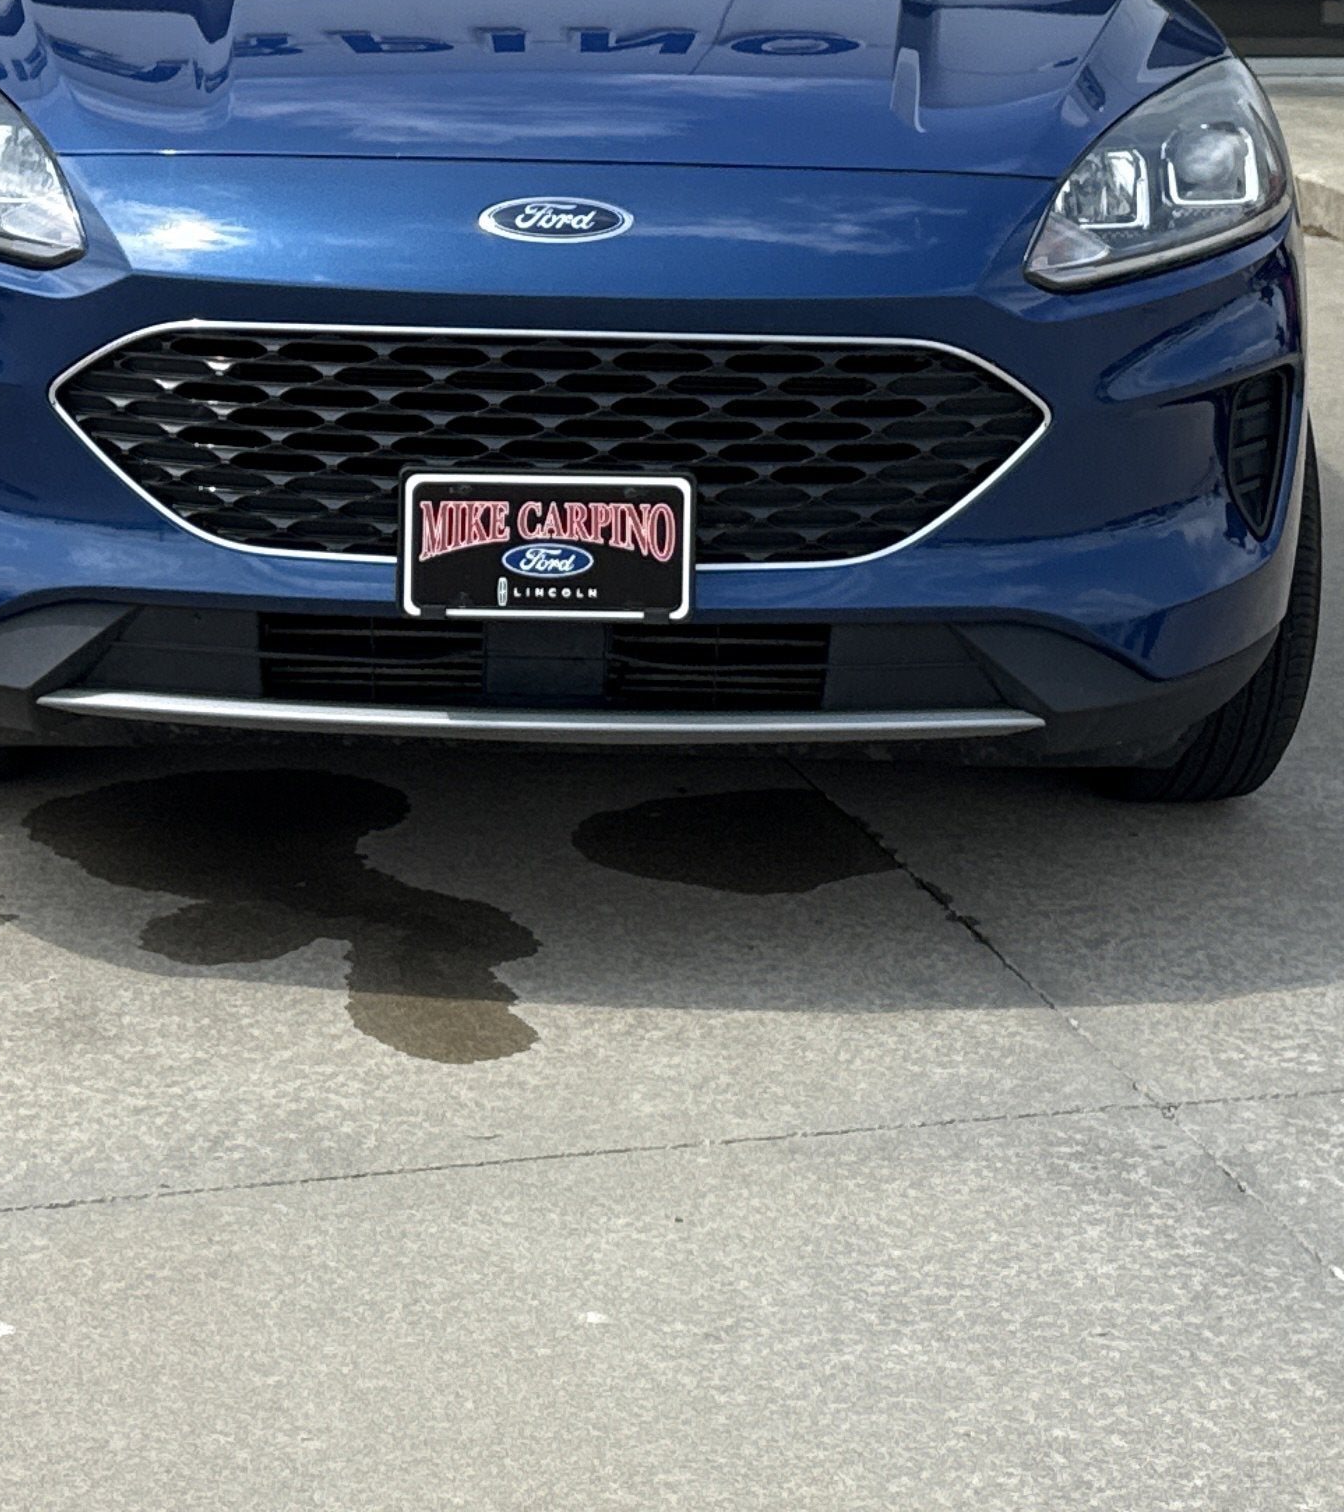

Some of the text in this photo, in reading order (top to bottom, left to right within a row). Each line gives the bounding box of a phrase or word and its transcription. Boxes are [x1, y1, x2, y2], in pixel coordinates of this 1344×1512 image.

[515, 203, 597, 230] Ford
[419, 500, 676, 562] MIKE CARPINO
[519, 548, 575, 572] Ford
[513, 587, 598, 598] LINCOLN
